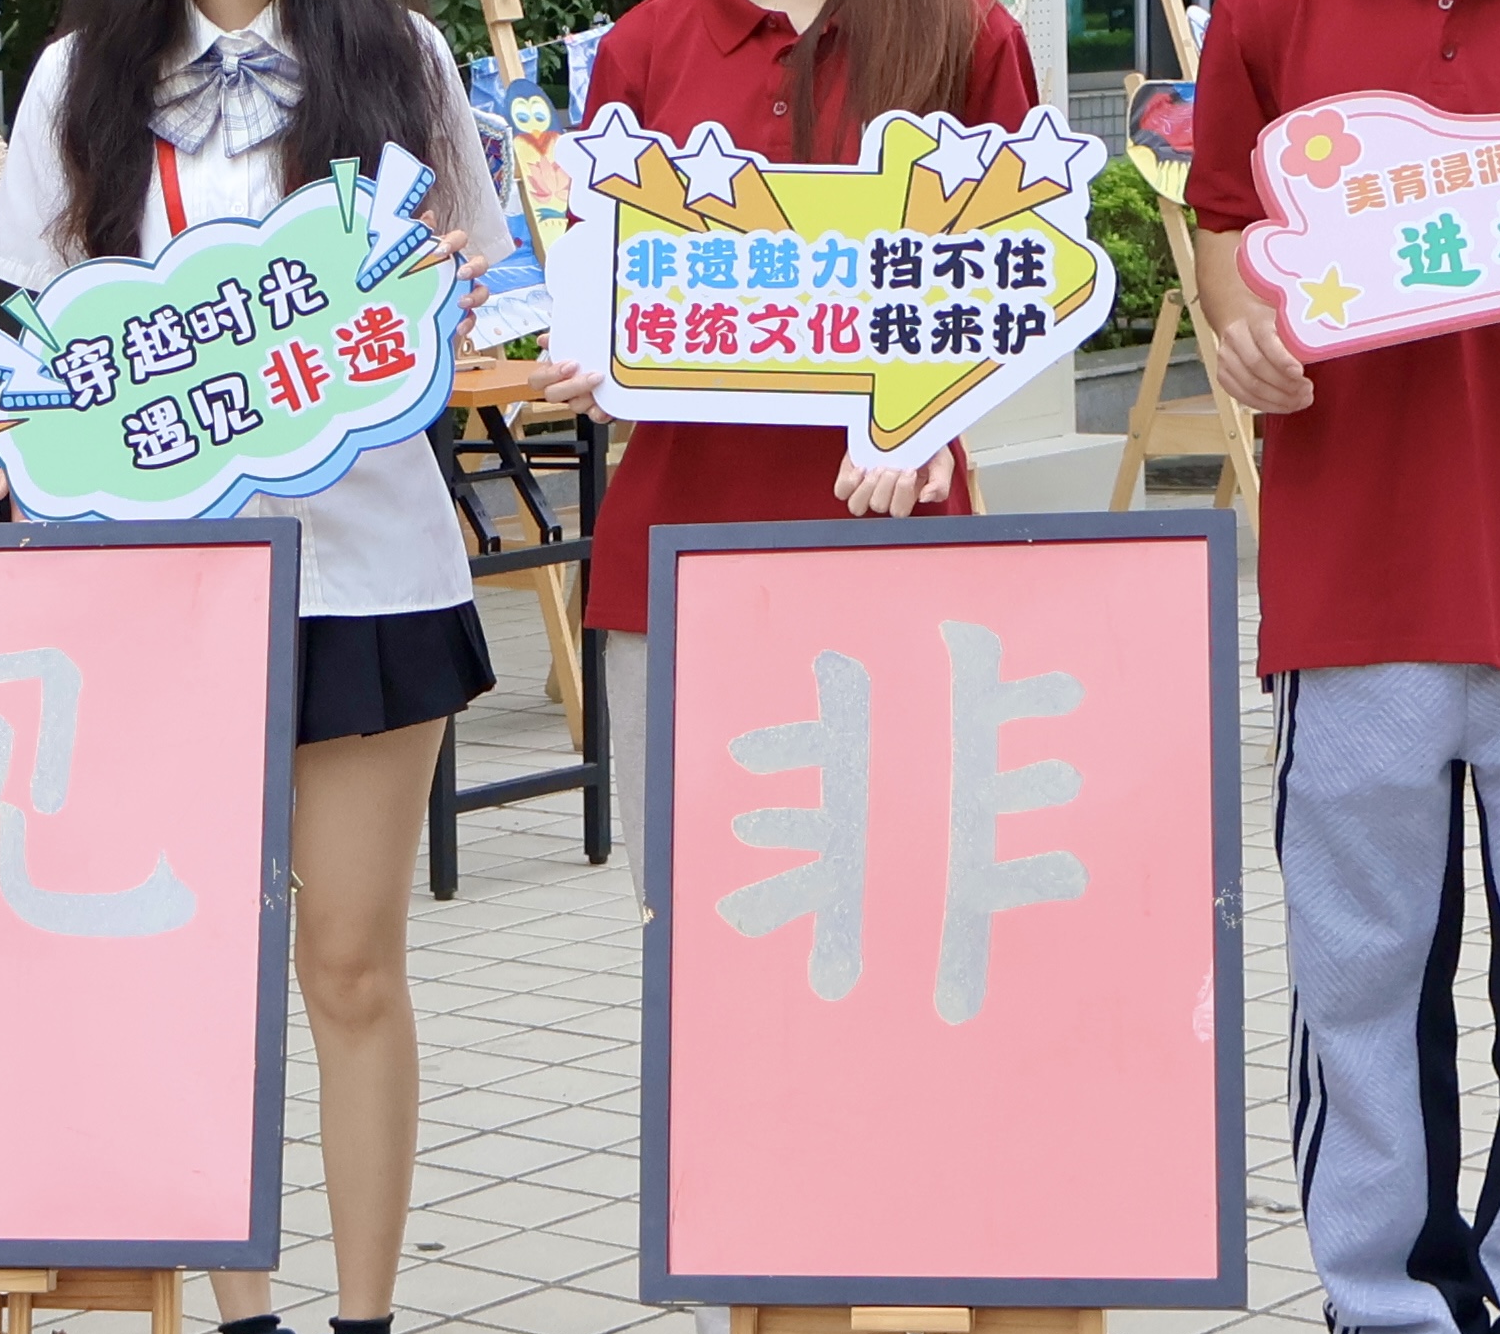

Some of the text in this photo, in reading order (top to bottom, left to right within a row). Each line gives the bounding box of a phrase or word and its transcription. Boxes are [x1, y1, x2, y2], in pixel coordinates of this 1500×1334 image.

[55, 258, 328, 408] 穿越时光
[624, 237, 1048, 291] 非遗魅力挡不住
[624, 302, 1048, 356] 传统文化我来护
[124, 305, 417, 468] 遇见非遗
[715, 619, 1090, 1025] 非
